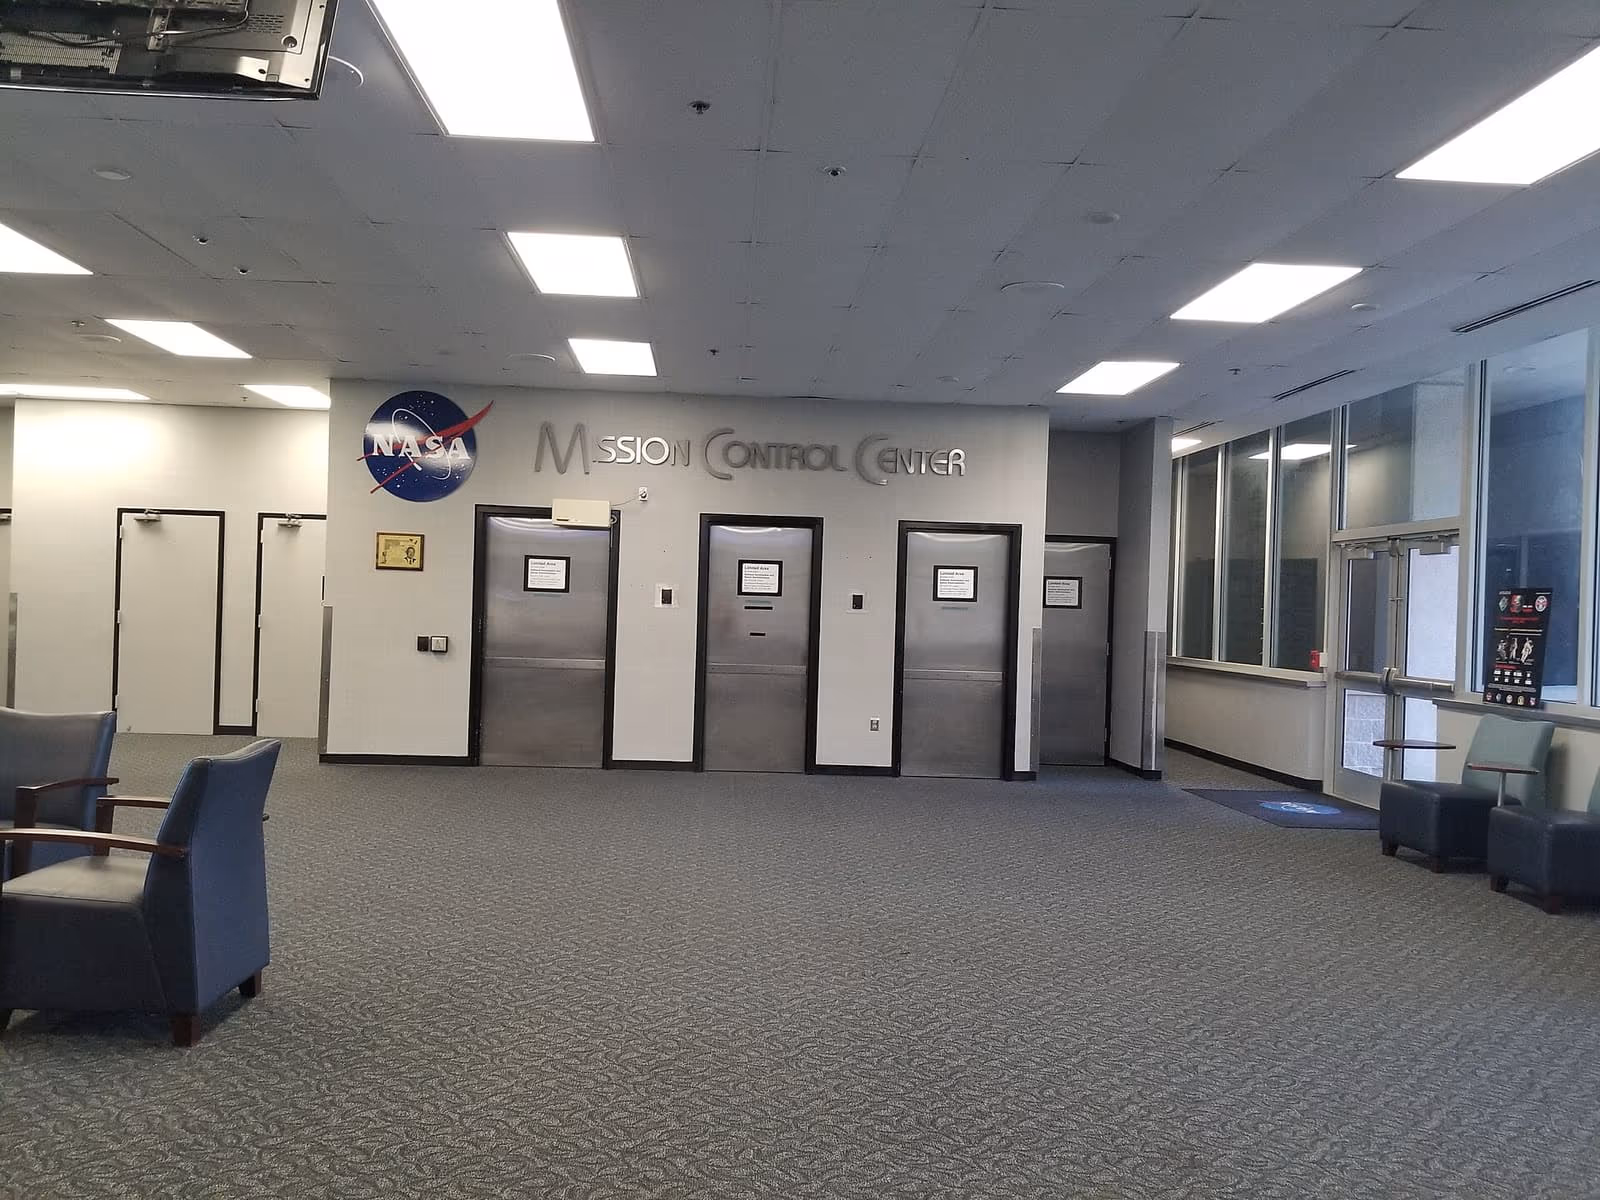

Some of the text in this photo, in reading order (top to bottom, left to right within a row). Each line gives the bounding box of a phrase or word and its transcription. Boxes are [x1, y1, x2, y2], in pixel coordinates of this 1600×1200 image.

[371, 434, 472, 460] NASA
[534, 421, 967, 486] MSSION CONTROL CENTER
